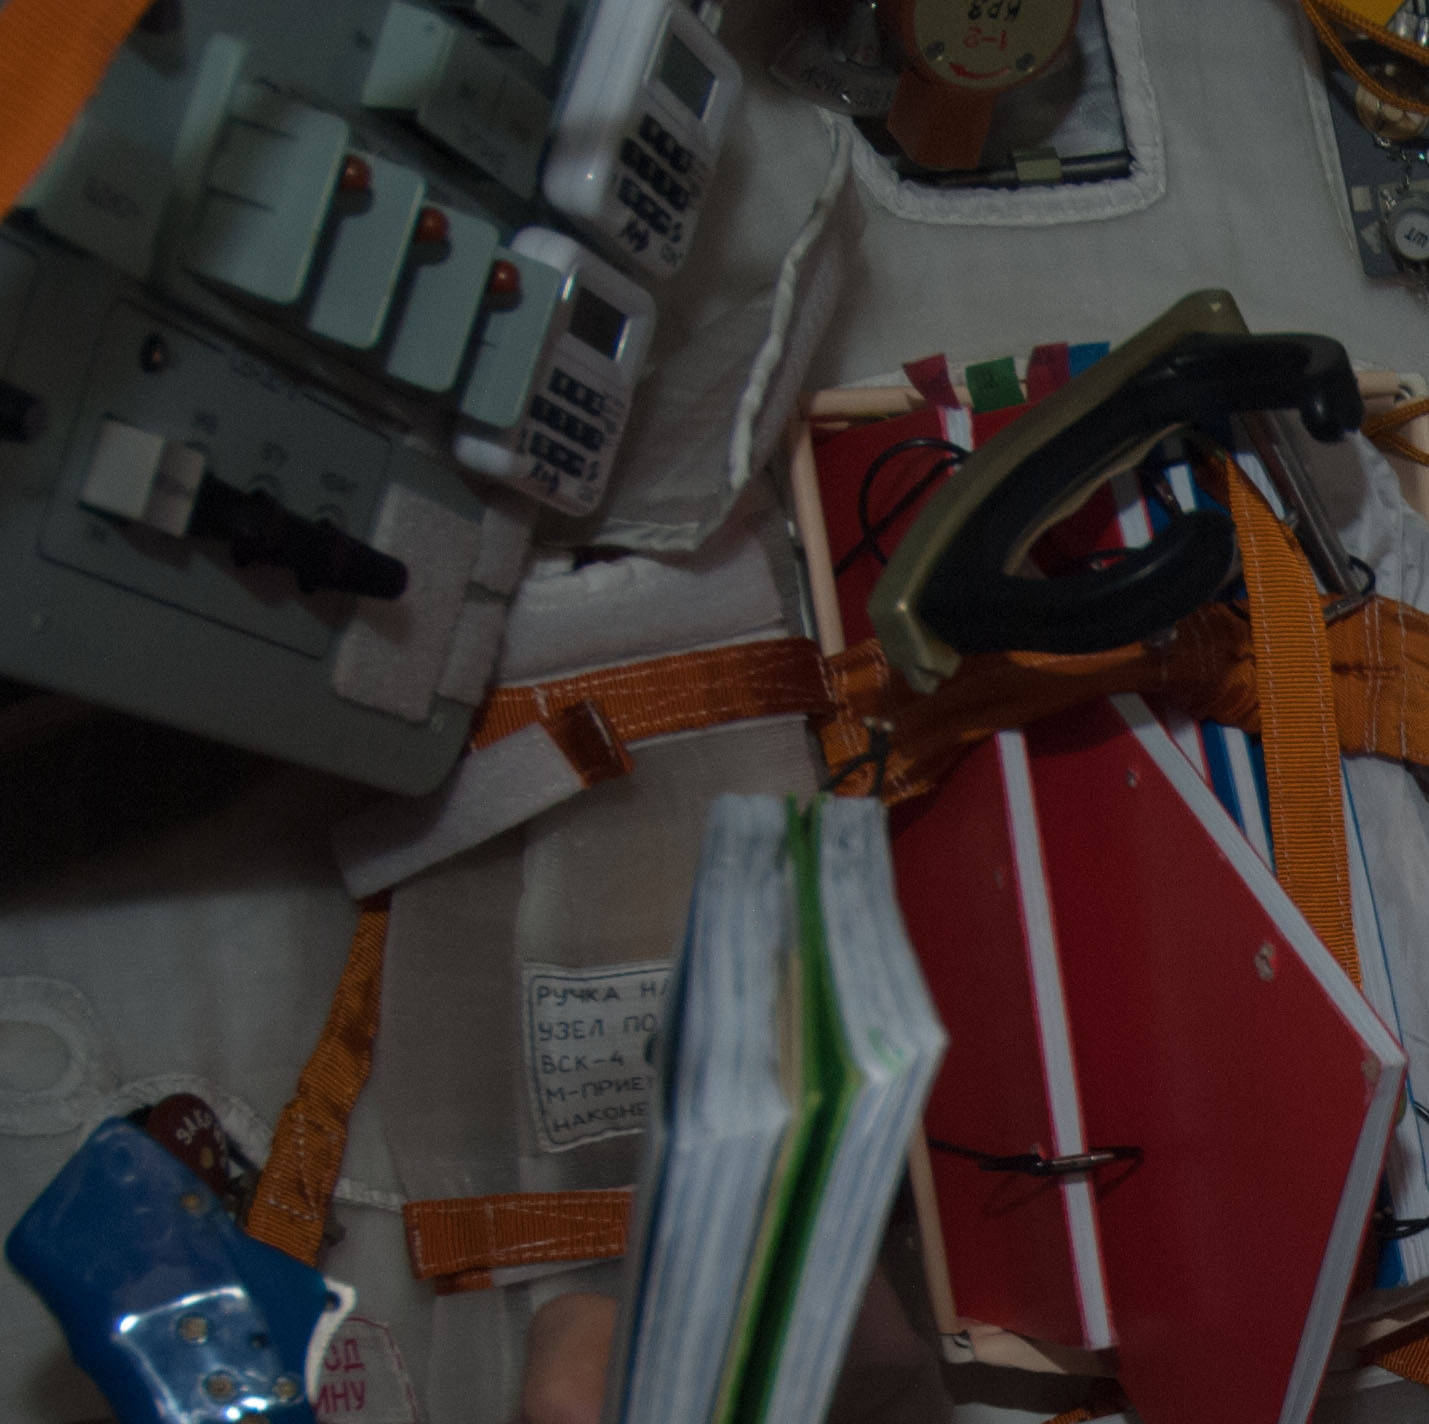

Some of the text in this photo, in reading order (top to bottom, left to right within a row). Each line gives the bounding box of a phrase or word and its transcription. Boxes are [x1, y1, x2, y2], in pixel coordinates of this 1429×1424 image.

[535, 985, 620, 1006] РУЧКА
[538, 1019, 605, 1041] УЗЕЛ
[541, 1051, 624, 1074] ВСК-4
[325, 1340, 365, 1372] ОД
[313, 1381, 366, 1413] ИНУ
